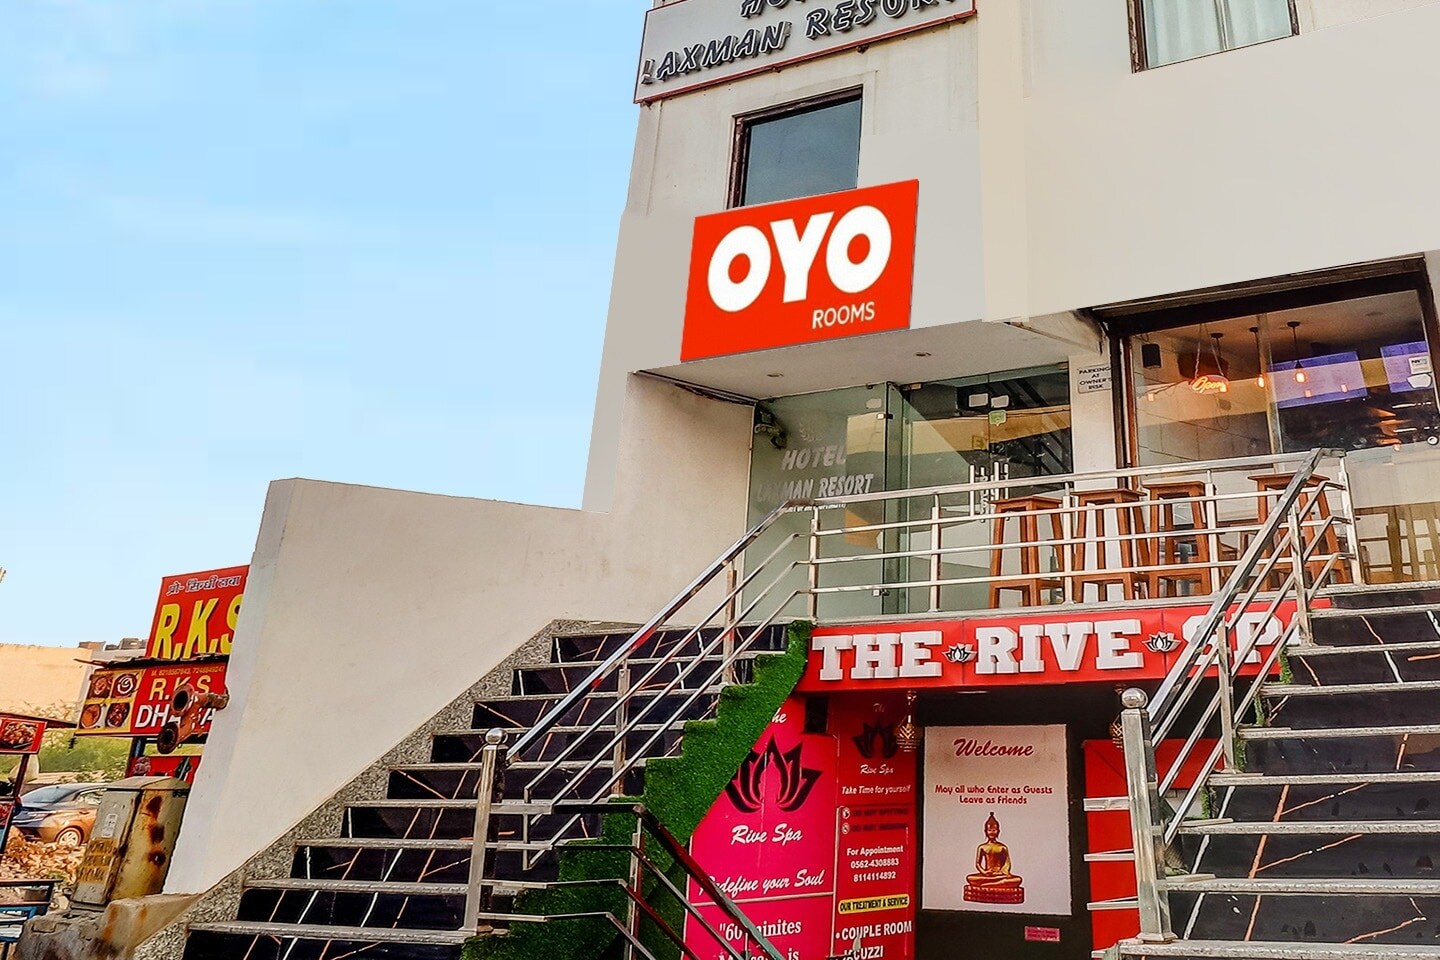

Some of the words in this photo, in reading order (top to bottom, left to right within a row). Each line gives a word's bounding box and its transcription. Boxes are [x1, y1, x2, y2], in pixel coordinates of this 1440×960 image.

[641, 21, 792, 84] LAXMAN
[707, 205, 892, 313] OYO
[811, 301, 876, 330] ROOMS
[782, 444, 847, 471] HOTEL
[818, 474, 874, 498] RESORT
[812, 630, 943, 681] THE
[975, 618, 1144, 675] RIVE
[771, 707, 788, 724] he
[953, 738, 1034, 756] Welcome
[842, 786, 857, 794] Take
[859, 785, 874, 794] Time
[875, 785, 884, 793] for
[885, 785, 911, 795] yourself
[935, 785, 953, 795] May
[967, 785, 984, 793] who
[987, 785, 1009, 794] Enter
[1023, 786, 1053, 794] Guests
[960, 795, 983, 804] Leave
[997, 795, 1027, 804] Friends
[731, 825, 767, 845] Rive
[772, 823, 803, 846] Spa
[847, 848, 859, 856] For
[860, 845, 904, 856] Appointment
[699, 875, 759, 898] define
[763, 878, 790, 894] your
[794, 869, 825, 887] Soul
[842, 924, 882, 940] COUPLE
[884, 921, 912, 936] ROOM
